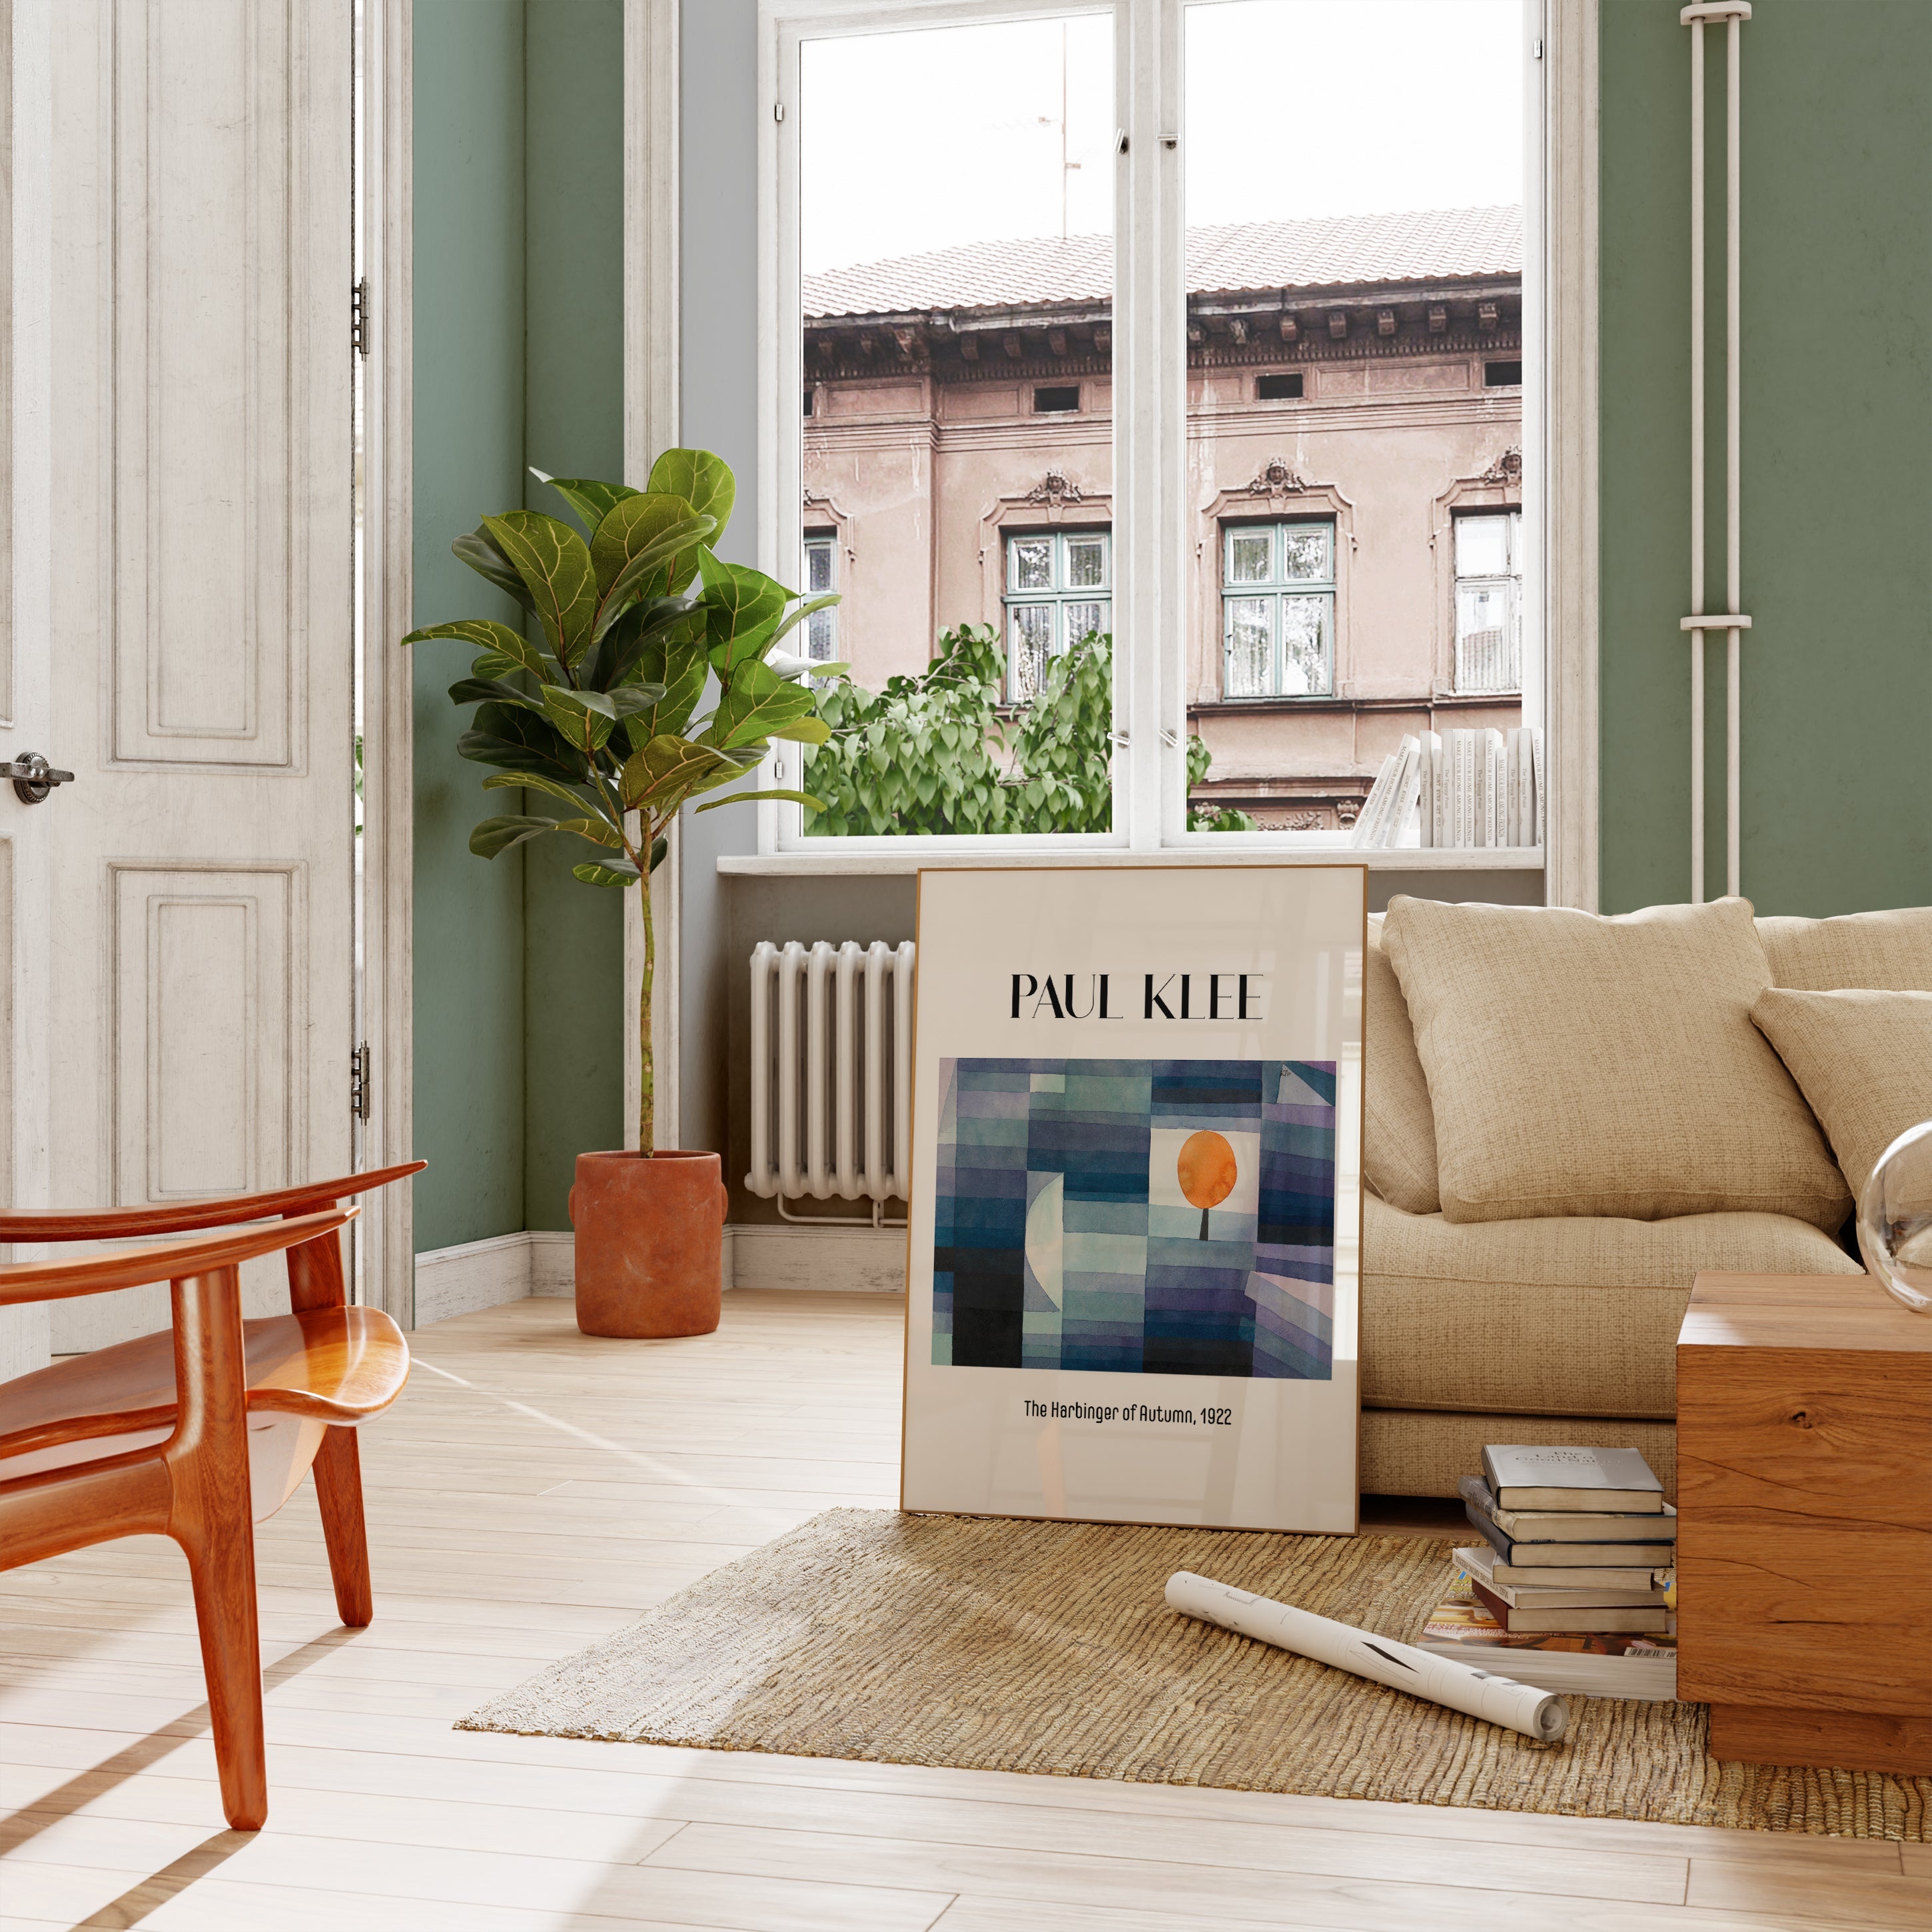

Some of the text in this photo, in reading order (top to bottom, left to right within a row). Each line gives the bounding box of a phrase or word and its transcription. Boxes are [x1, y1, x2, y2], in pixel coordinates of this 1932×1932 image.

[1398, 745, 1407, 761] MAKE
[1378, 796, 1389, 816] AMONG
[1370, 817, 1381, 841] FRIENDS
[1010, 974, 1264, 1019] PAUL KLEE
[1024, 1400, 1232, 1425] The Harbinger of Autumn, 1922
